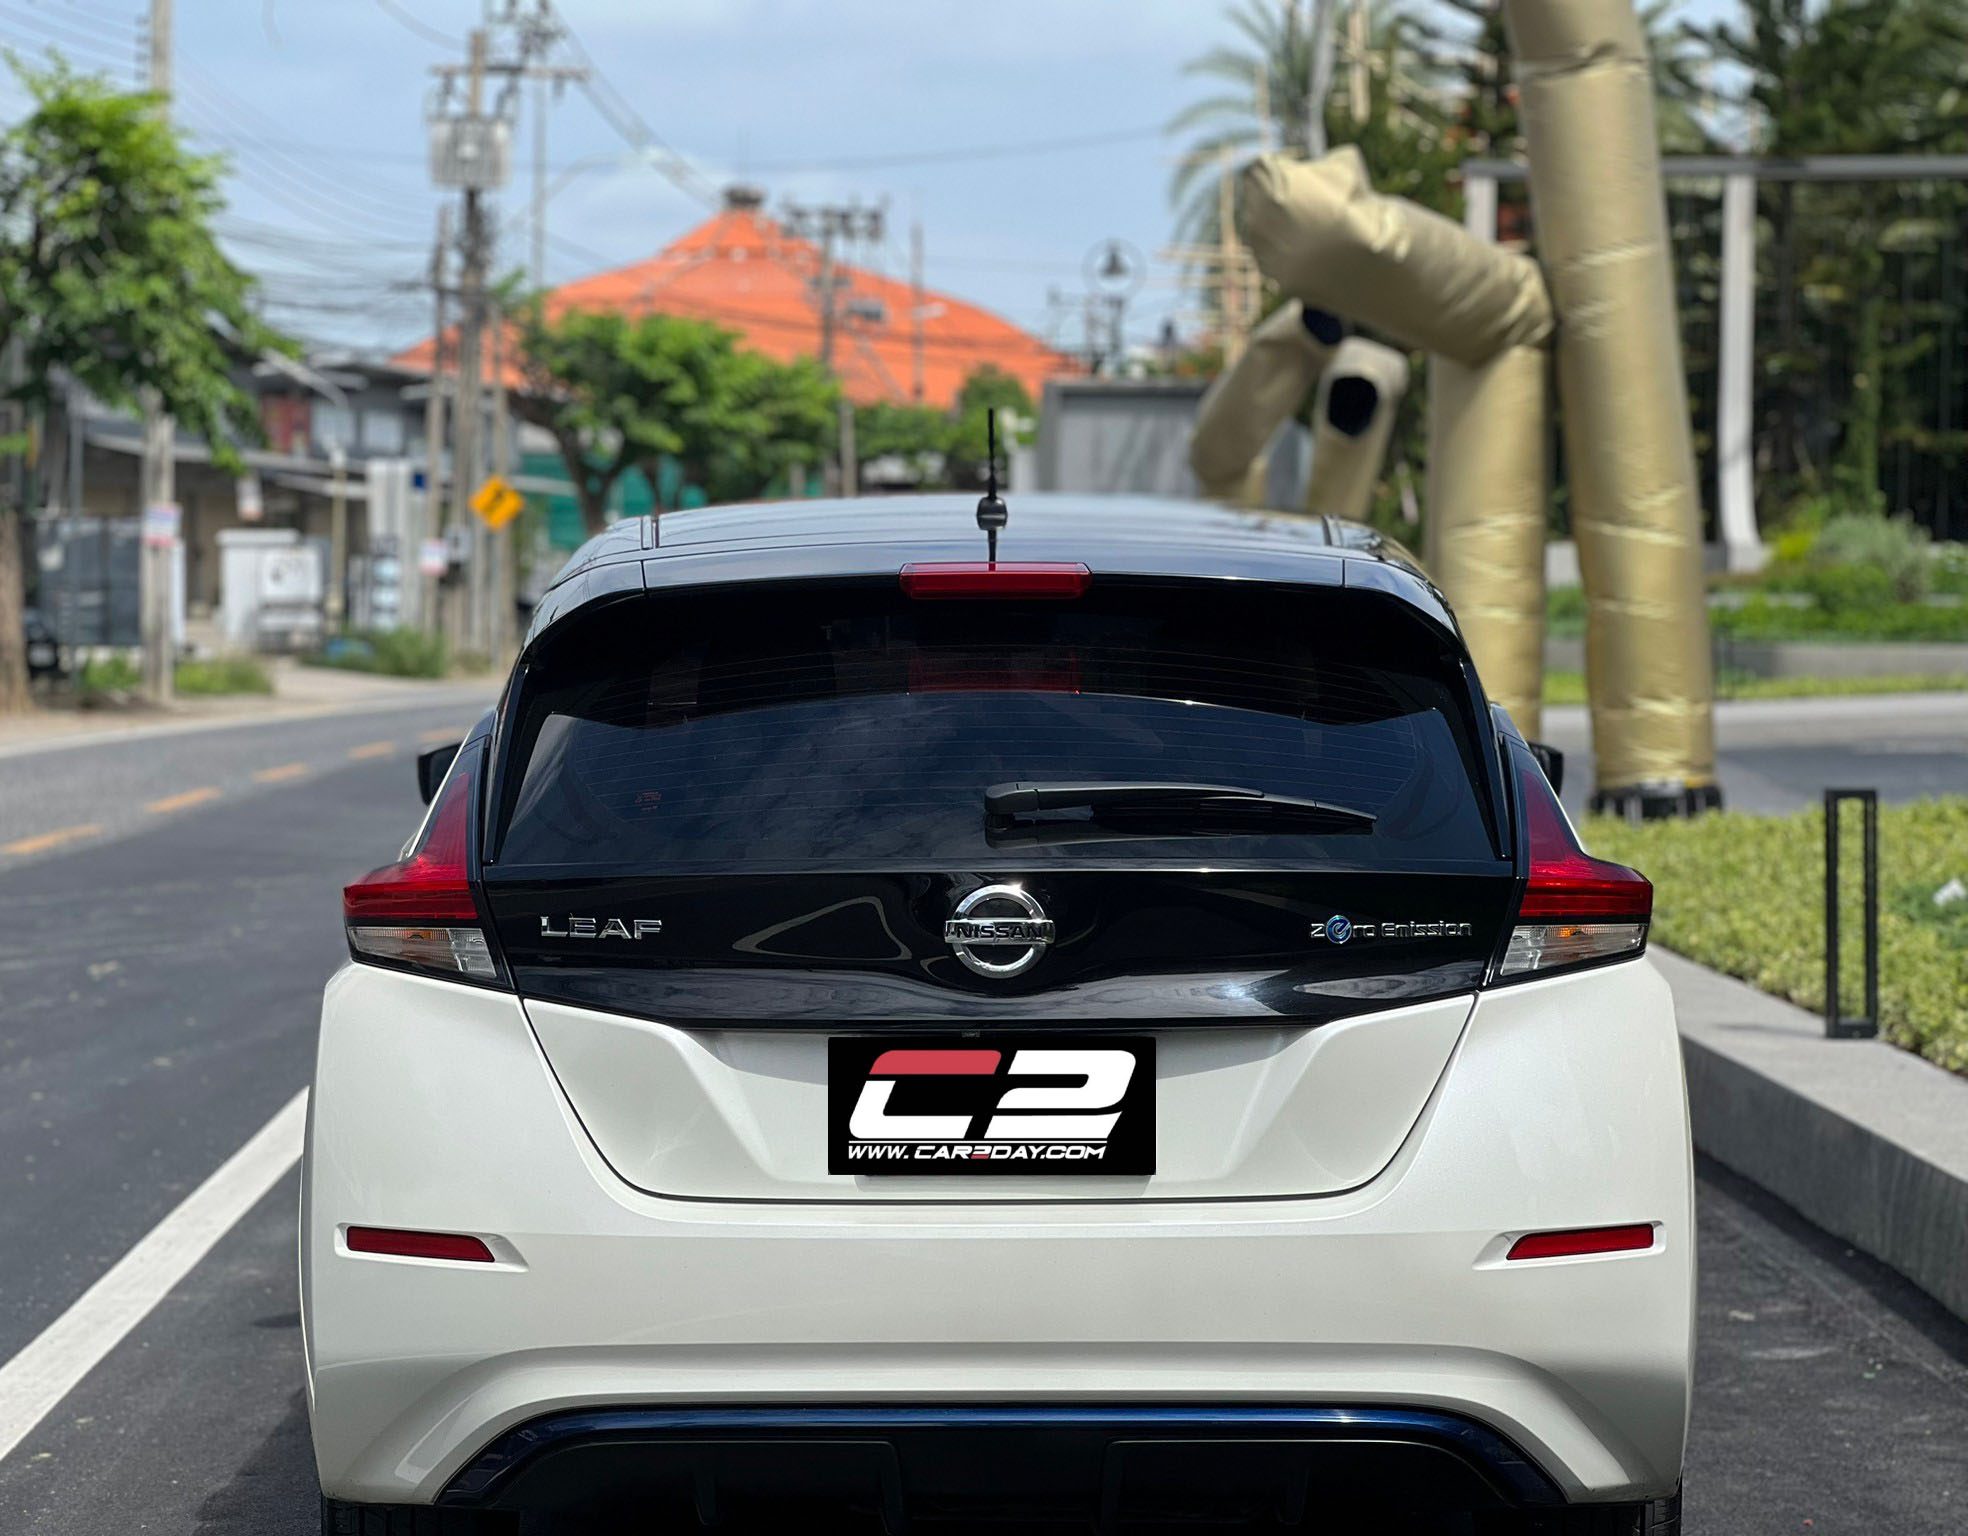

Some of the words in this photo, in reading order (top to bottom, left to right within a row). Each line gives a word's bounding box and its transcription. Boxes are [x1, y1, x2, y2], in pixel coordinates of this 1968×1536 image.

[540, 916, 662, 940] LEAF
[956, 925, 1042, 939] NISSAN
[1381, 920, 1473, 937] Emission
